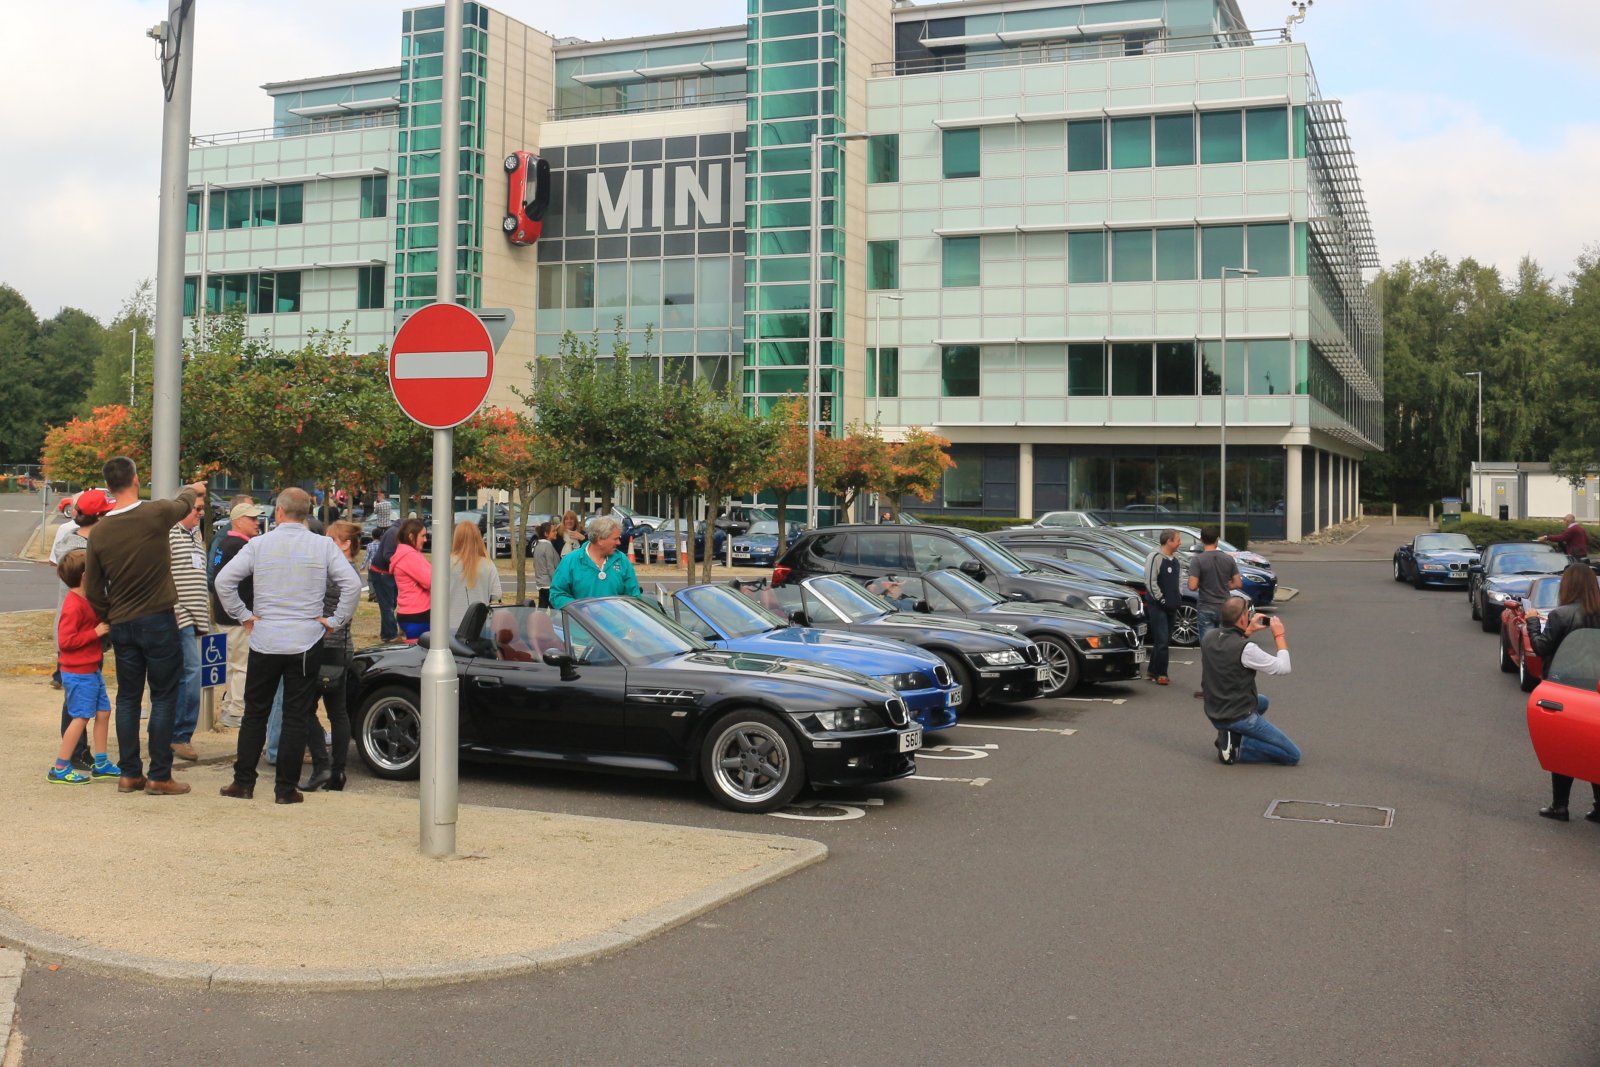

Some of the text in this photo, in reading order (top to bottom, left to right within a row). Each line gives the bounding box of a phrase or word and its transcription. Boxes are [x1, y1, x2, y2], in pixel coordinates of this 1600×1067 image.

[586, 161, 746, 232] MINI
[210, 666, 219, 684] 6
[906, 732, 920, 748] S60
